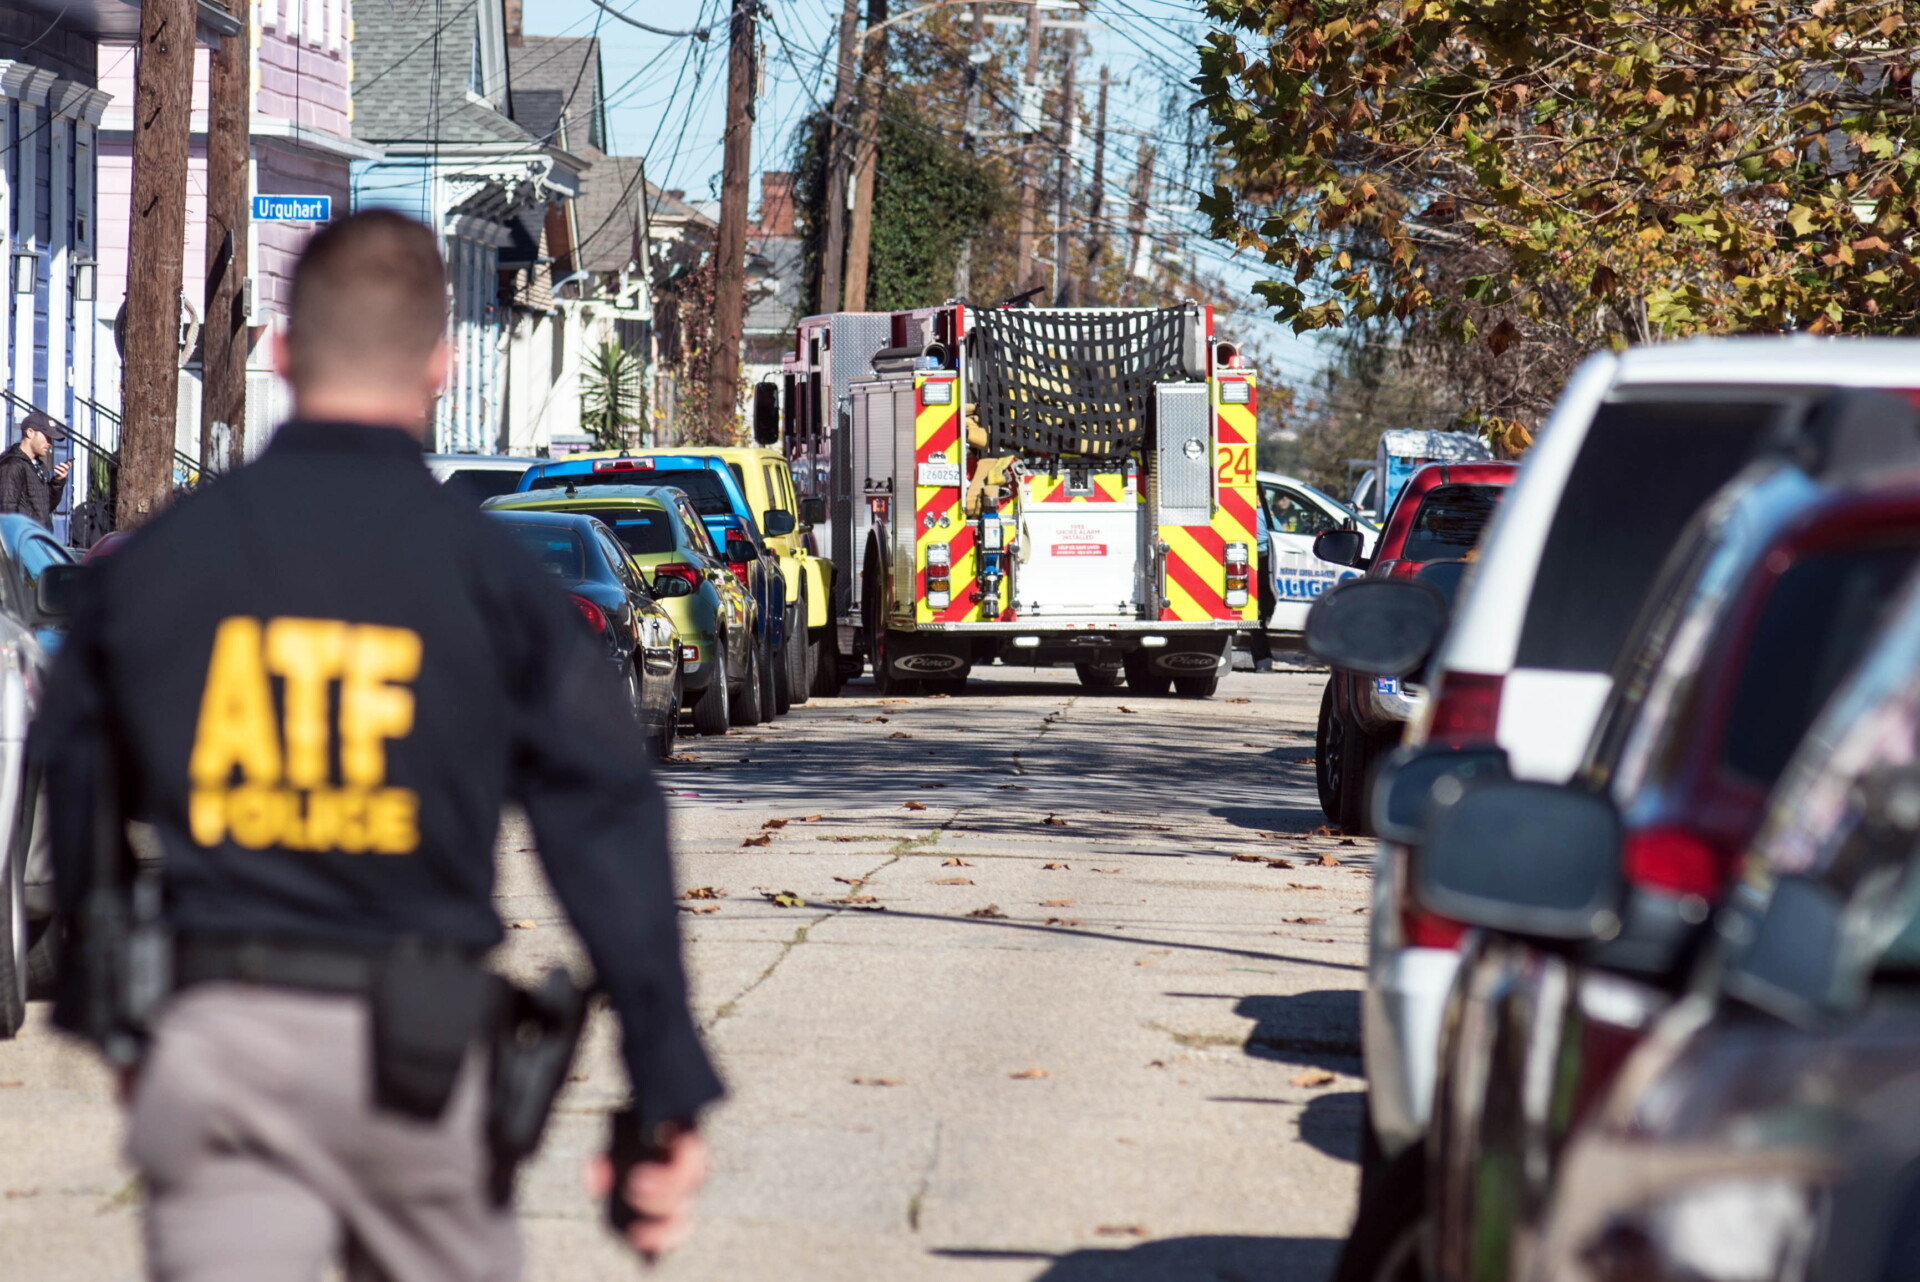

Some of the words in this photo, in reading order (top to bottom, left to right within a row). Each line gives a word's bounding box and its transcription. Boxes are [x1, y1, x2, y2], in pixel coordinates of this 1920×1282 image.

[259, 199, 322, 220] Urquhart
[1218, 447, 1252, 483] 24
[908, 657, 953, 668] Pierce
[1167, 656, 1213, 666] Pierce
[188, 614, 424, 788] ATF
